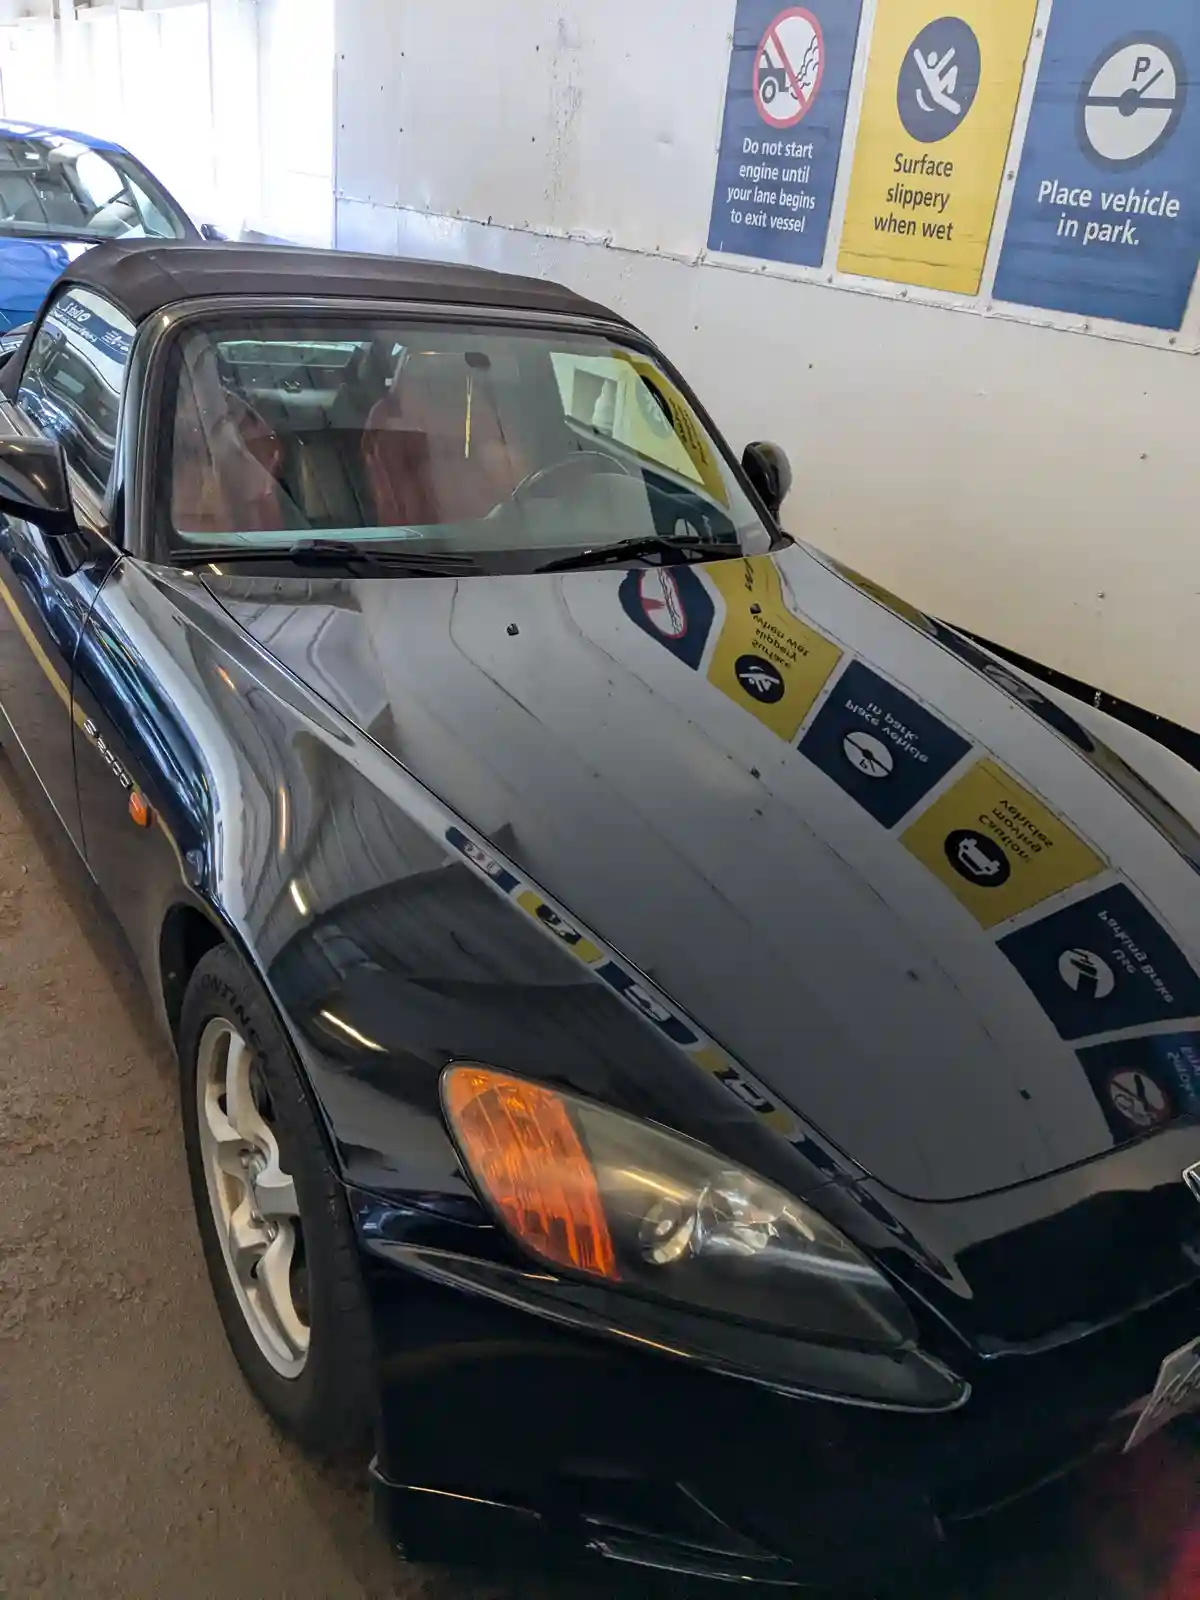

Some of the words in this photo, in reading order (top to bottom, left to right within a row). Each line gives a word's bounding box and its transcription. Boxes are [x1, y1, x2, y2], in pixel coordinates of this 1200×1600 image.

[1131, 56, 1151, 82] P
[742, 138, 759, 154] Do
[761, 140, 783, 156] not
[784, 141, 814, 159] start
[739, 162, 779, 183] engine
[782, 165, 811, 183] until
[893, 151, 954, 177] Surface
[725, 186, 752, 204] your
[753, 186, 777, 204] lane
[779, 188, 816, 212] begins
[886, 182, 951, 214] slippery
[1038, 179, 1093, 208] Place
[1101, 187, 1181, 218] vehicle
[730, 208, 743, 224] to
[745, 209, 768, 228] exit
[770, 215, 806, 233] vessel
[874, 211, 917, 236] when
[921, 221, 954, 241] wet
[1056, 212, 1079, 237] in
[1082, 219, 1140, 246] park.
